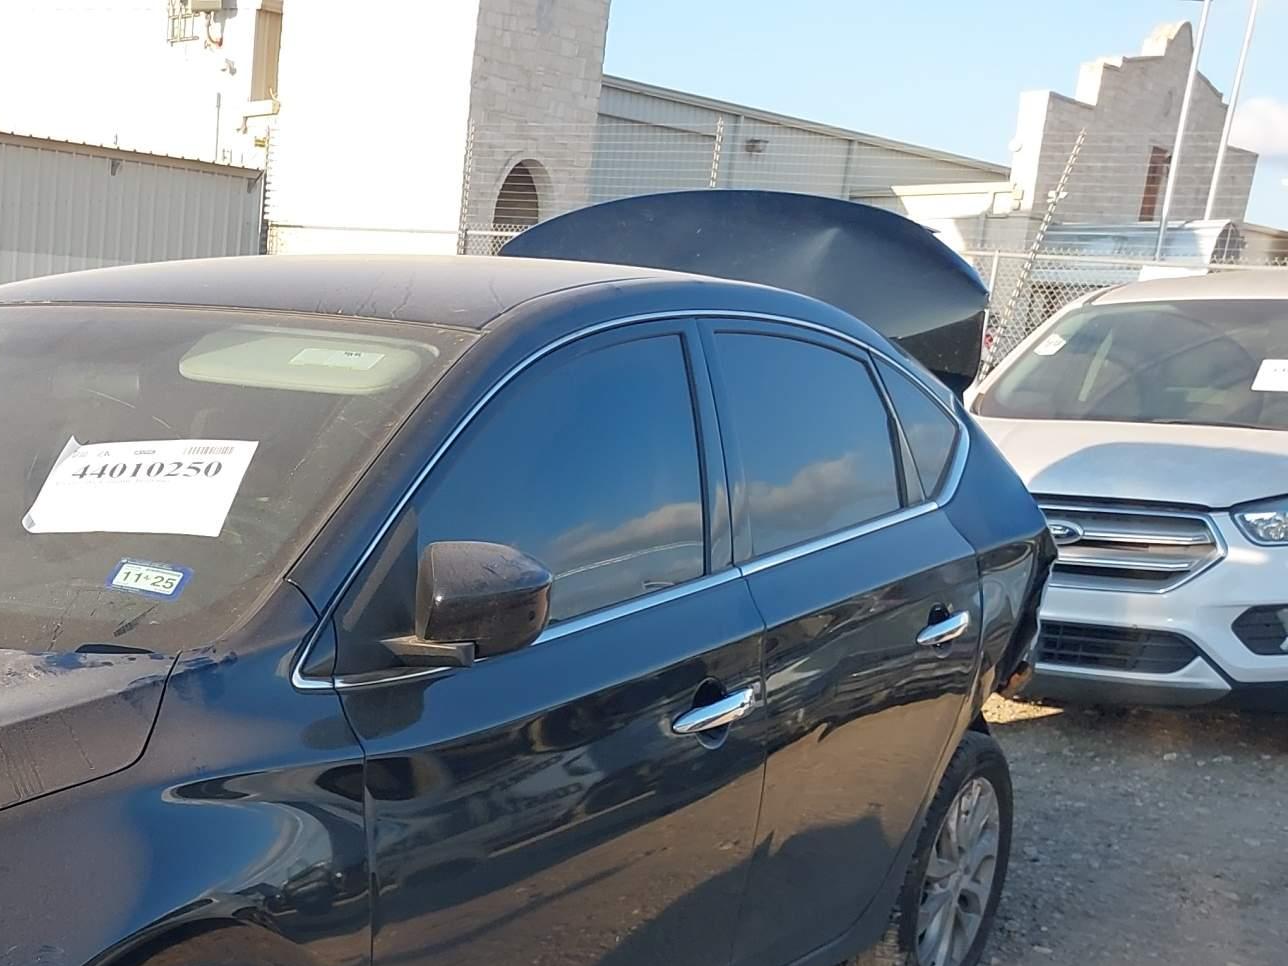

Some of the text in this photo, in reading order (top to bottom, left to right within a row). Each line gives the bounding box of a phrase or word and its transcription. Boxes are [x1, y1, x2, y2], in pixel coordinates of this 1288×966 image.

[71, 460, 224, 480] 44010250
[122, 570, 143, 584] 11
[150, 575, 177, 590] 25
